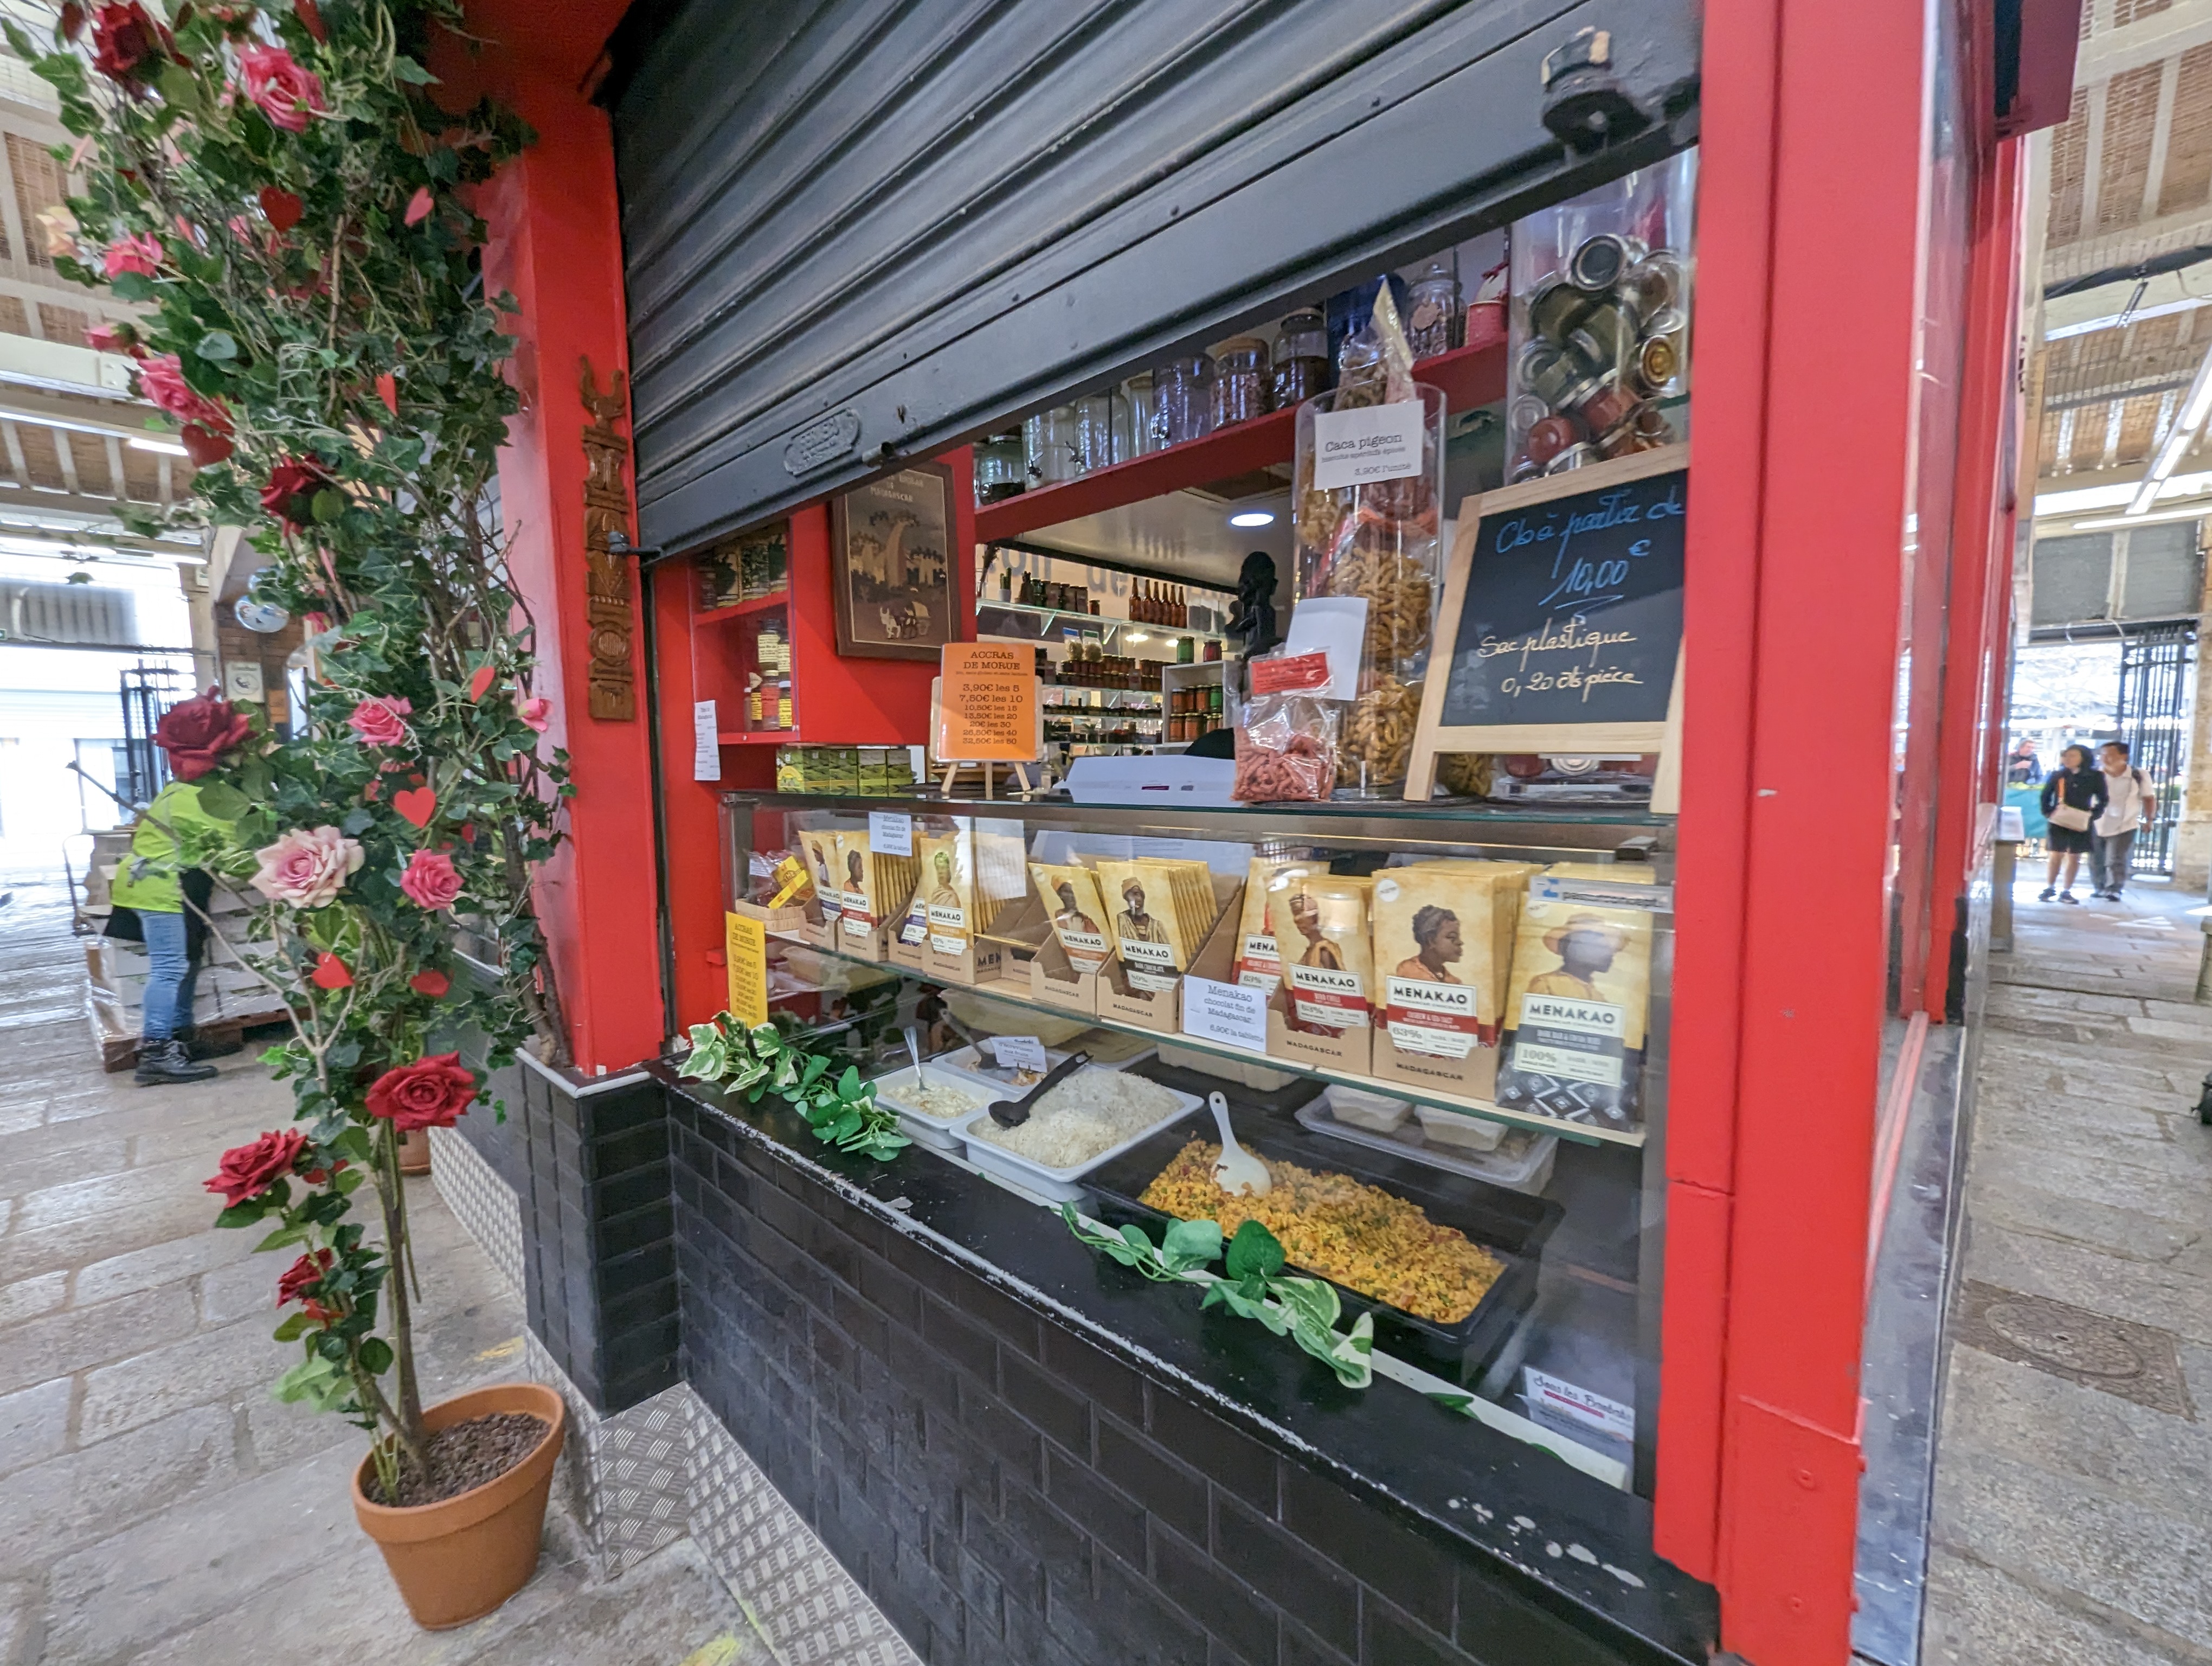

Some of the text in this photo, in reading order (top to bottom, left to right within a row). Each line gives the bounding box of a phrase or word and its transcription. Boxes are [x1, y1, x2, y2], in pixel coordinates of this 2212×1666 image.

[1325, 434, 1403, 452] Caca pigeon
[1551, 489, 1641, 579] partir
[1539, 539, 1651, 606] 10,00 €
[1477, 617, 1638, 672] Sac plastique
[970, 651, 1014, 659] ACCRAS
[981, 662, 1020, 670] MORUE
[963, 684, 993, 692] 3,90€
[959, 695, 990, 703] 7,50€
[1010, 695, 1023, 703] 10
[819, 889, 840, 899] MENAKAO
[844, 896, 866, 906] MENAKAO
[930, 910, 961, 921] MENAKAO
[1063, 934, 1102, 946] MENAKAO
[1249, 942, 1275, 952] MENA
[1124, 944, 1169, 958] MENAKAO
[1295, 972, 1356, 988] MENAKAO
[1207, 984, 1252, 1002] Menakao
[1393, 986, 1468, 1004] MENAKAO
[1113, 1003, 1153, 1017] MADAGASCAR
[1204, 997, 1234, 1009] chocolat
[1246, 1006, 1256, 1014] de
[1207, 1007, 1252, 1023] Madagascar
[1529, 1004, 1616, 1024] MENAKAO
[1392, 1027, 1423, 1039] 63%
[1287, 1040, 1342, 1056] MADAGASCAR
[1522, 1049, 1557, 1063] 100%
[1396, 1062, 1463, 1080] MADAGASCAR
